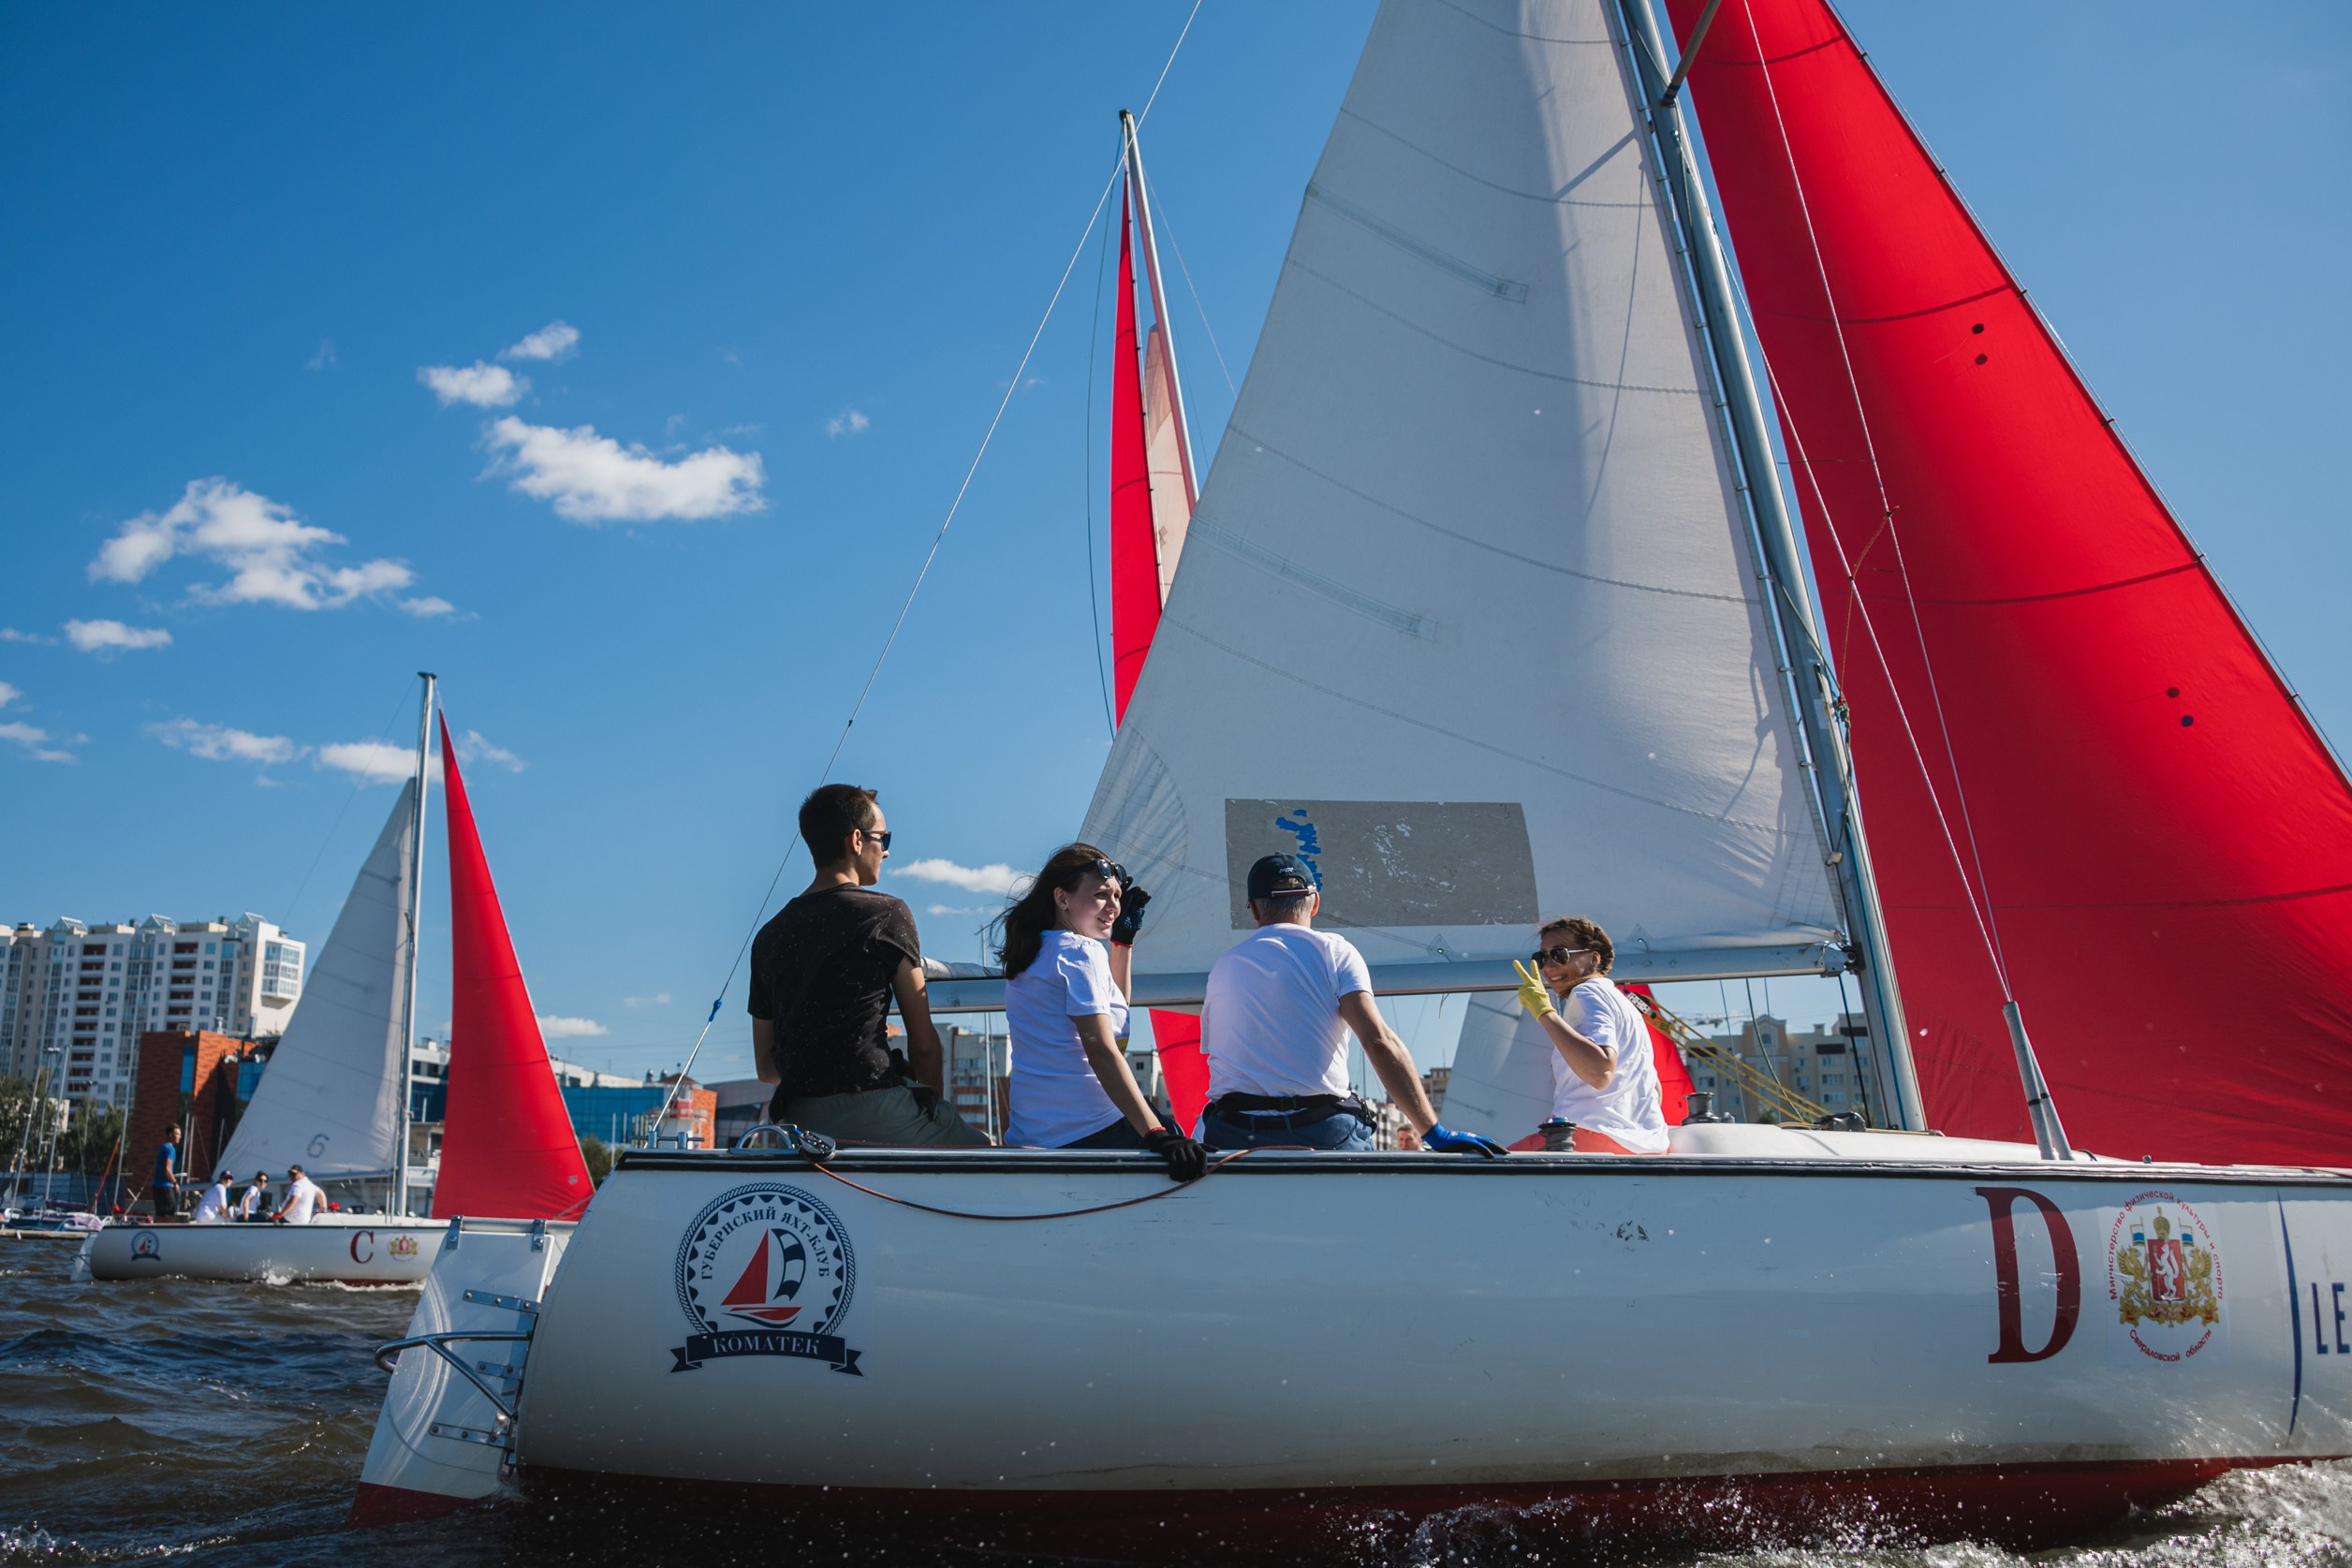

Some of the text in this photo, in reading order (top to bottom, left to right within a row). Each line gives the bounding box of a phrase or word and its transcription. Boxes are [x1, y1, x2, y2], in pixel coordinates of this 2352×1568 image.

[307, 1133, 330, 1158] 6
[350, 1229, 374, 1264] C
[701, 1206, 830, 1281] ГУБЕРНСКИЙ ЯХТ-КЛУБ
[2108, 1190, 2224, 1300] Министерство физической культуры и спорта
[1975, 1186, 2080, 1364] D
[713, 1335, 820, 1356] КОМАТЕК
[2129, 1328, 2212, 1362] Свердловской области
